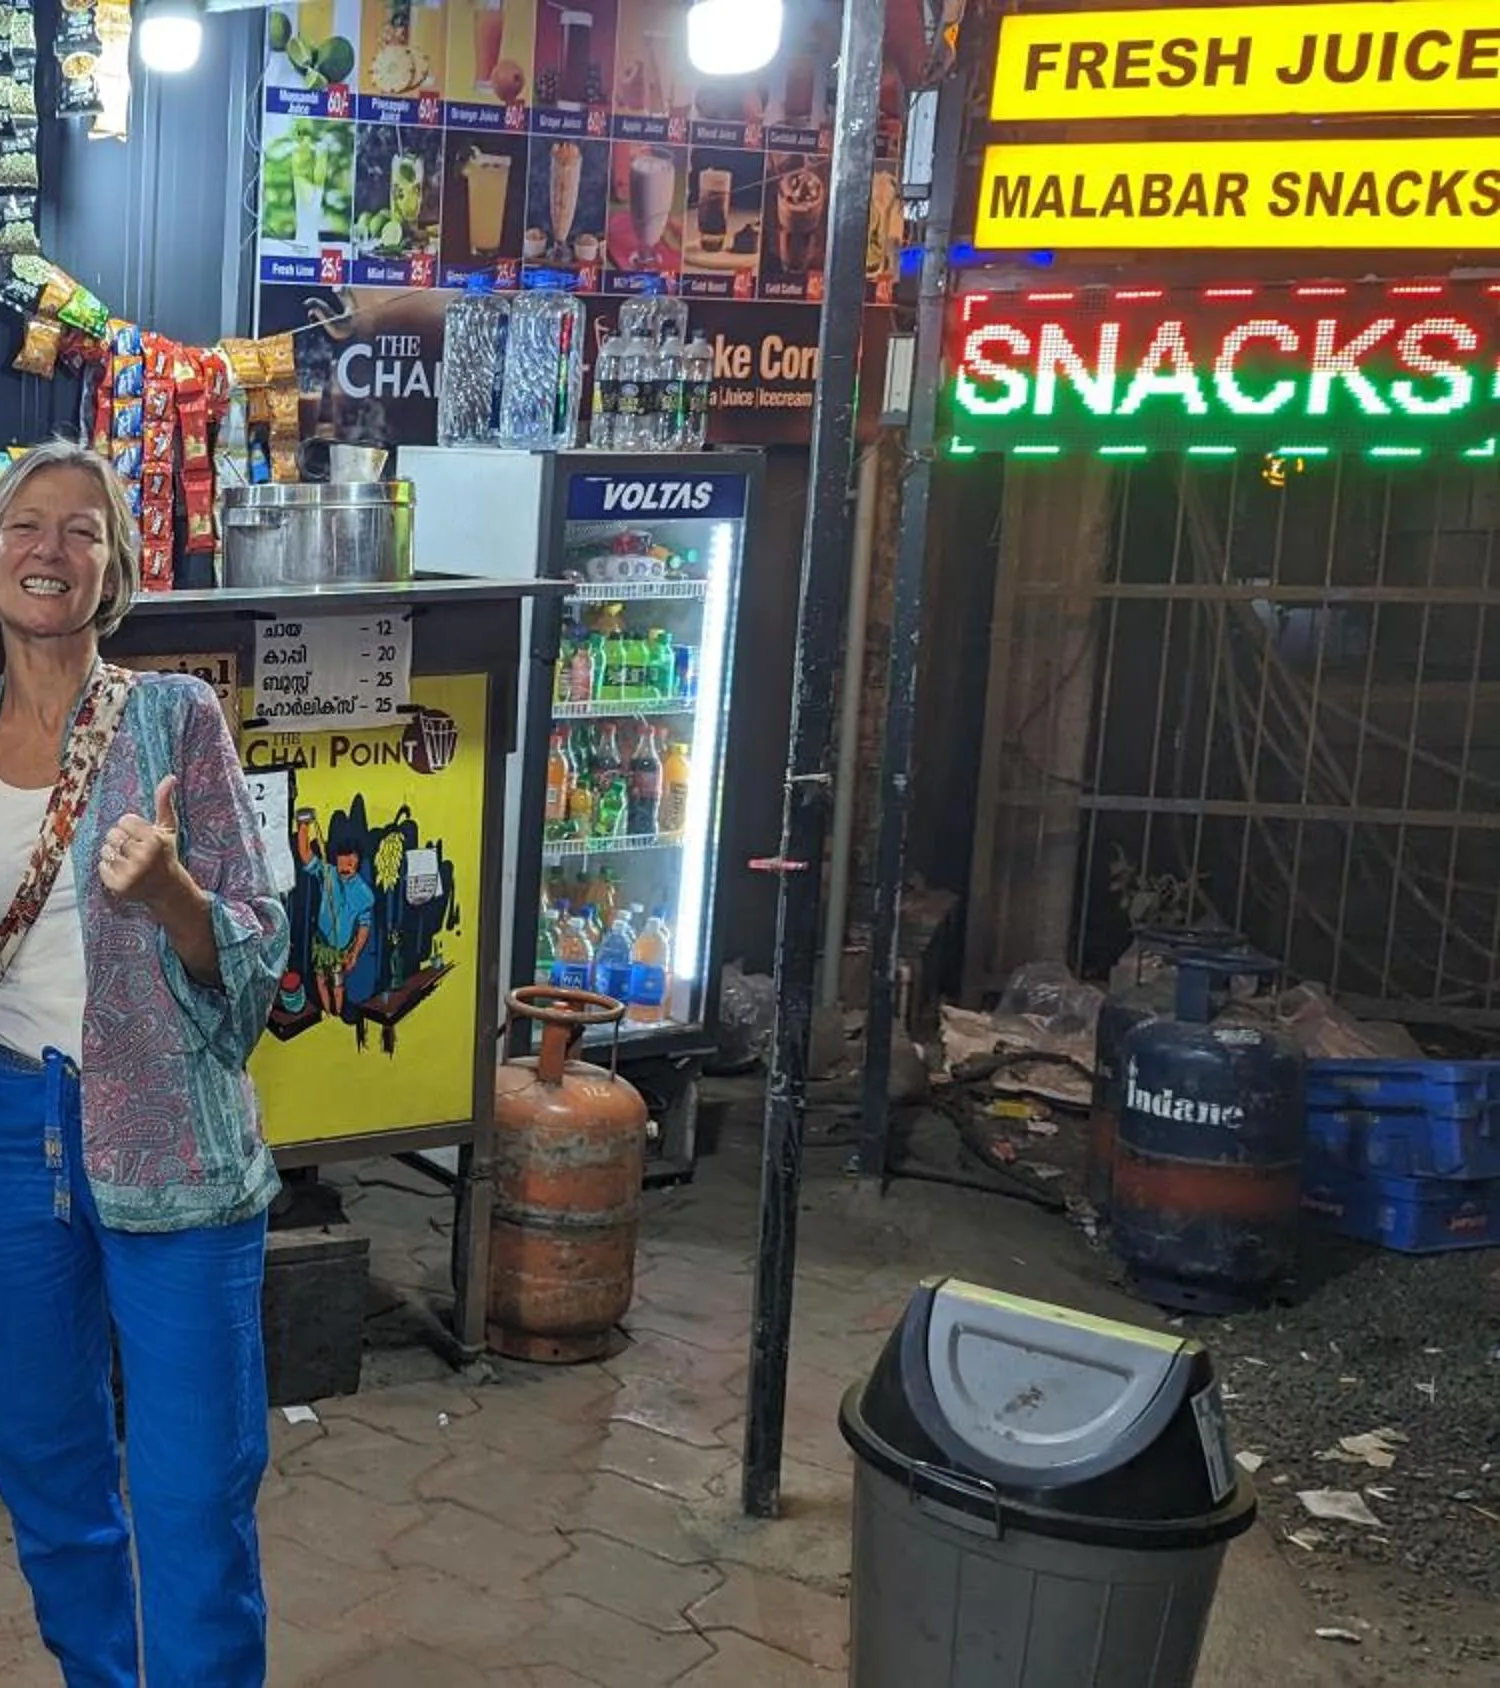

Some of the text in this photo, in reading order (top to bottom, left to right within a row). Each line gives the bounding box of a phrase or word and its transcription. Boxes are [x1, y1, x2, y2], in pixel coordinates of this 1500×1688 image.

[1023, 28, 1500, 91] FRESH JUICE
[989, 169, 1500, 220] MALABAR SNACKS
[272, 262, 315, 277] Fresh Lime
[376, 334, 421, 358] THE
[956, 318, 1477, 416] SNACKS
[603, 481, 713, 511] VOLTAS
[376, 619, 394, 636] 12
[377, 645, 396, 661] 20
[376, 671, 394, 687] 25
[375, 697, 393, 713] 25
[246, 735, 418, 769] CHAI POINT
